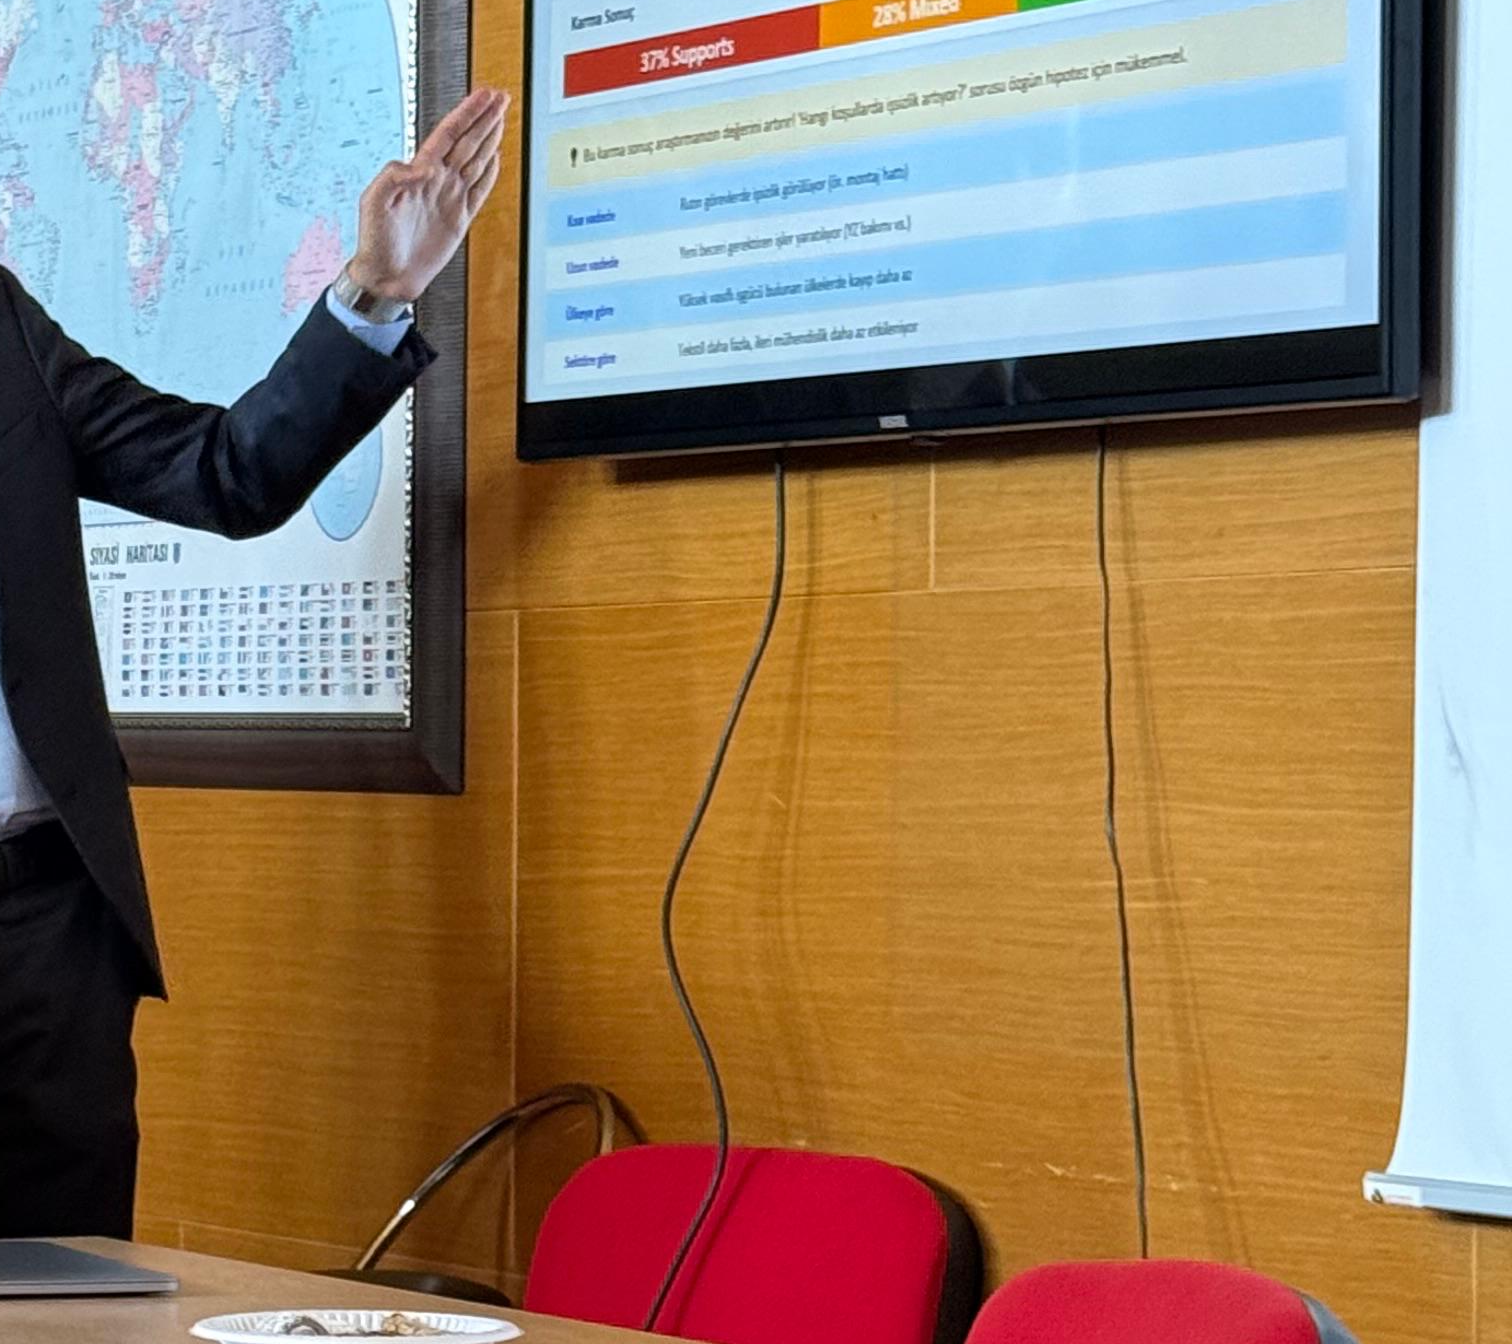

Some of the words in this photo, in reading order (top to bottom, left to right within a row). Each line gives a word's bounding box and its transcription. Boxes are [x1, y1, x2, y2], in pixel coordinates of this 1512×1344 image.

[571, 13, 602, 31] Karma
[605, 7, 635, 24] Sonuç
[872, 2, 906, 29] 28%
[639, 47, 669, 73] 37%
[671, 36, 735, 70] Supports
